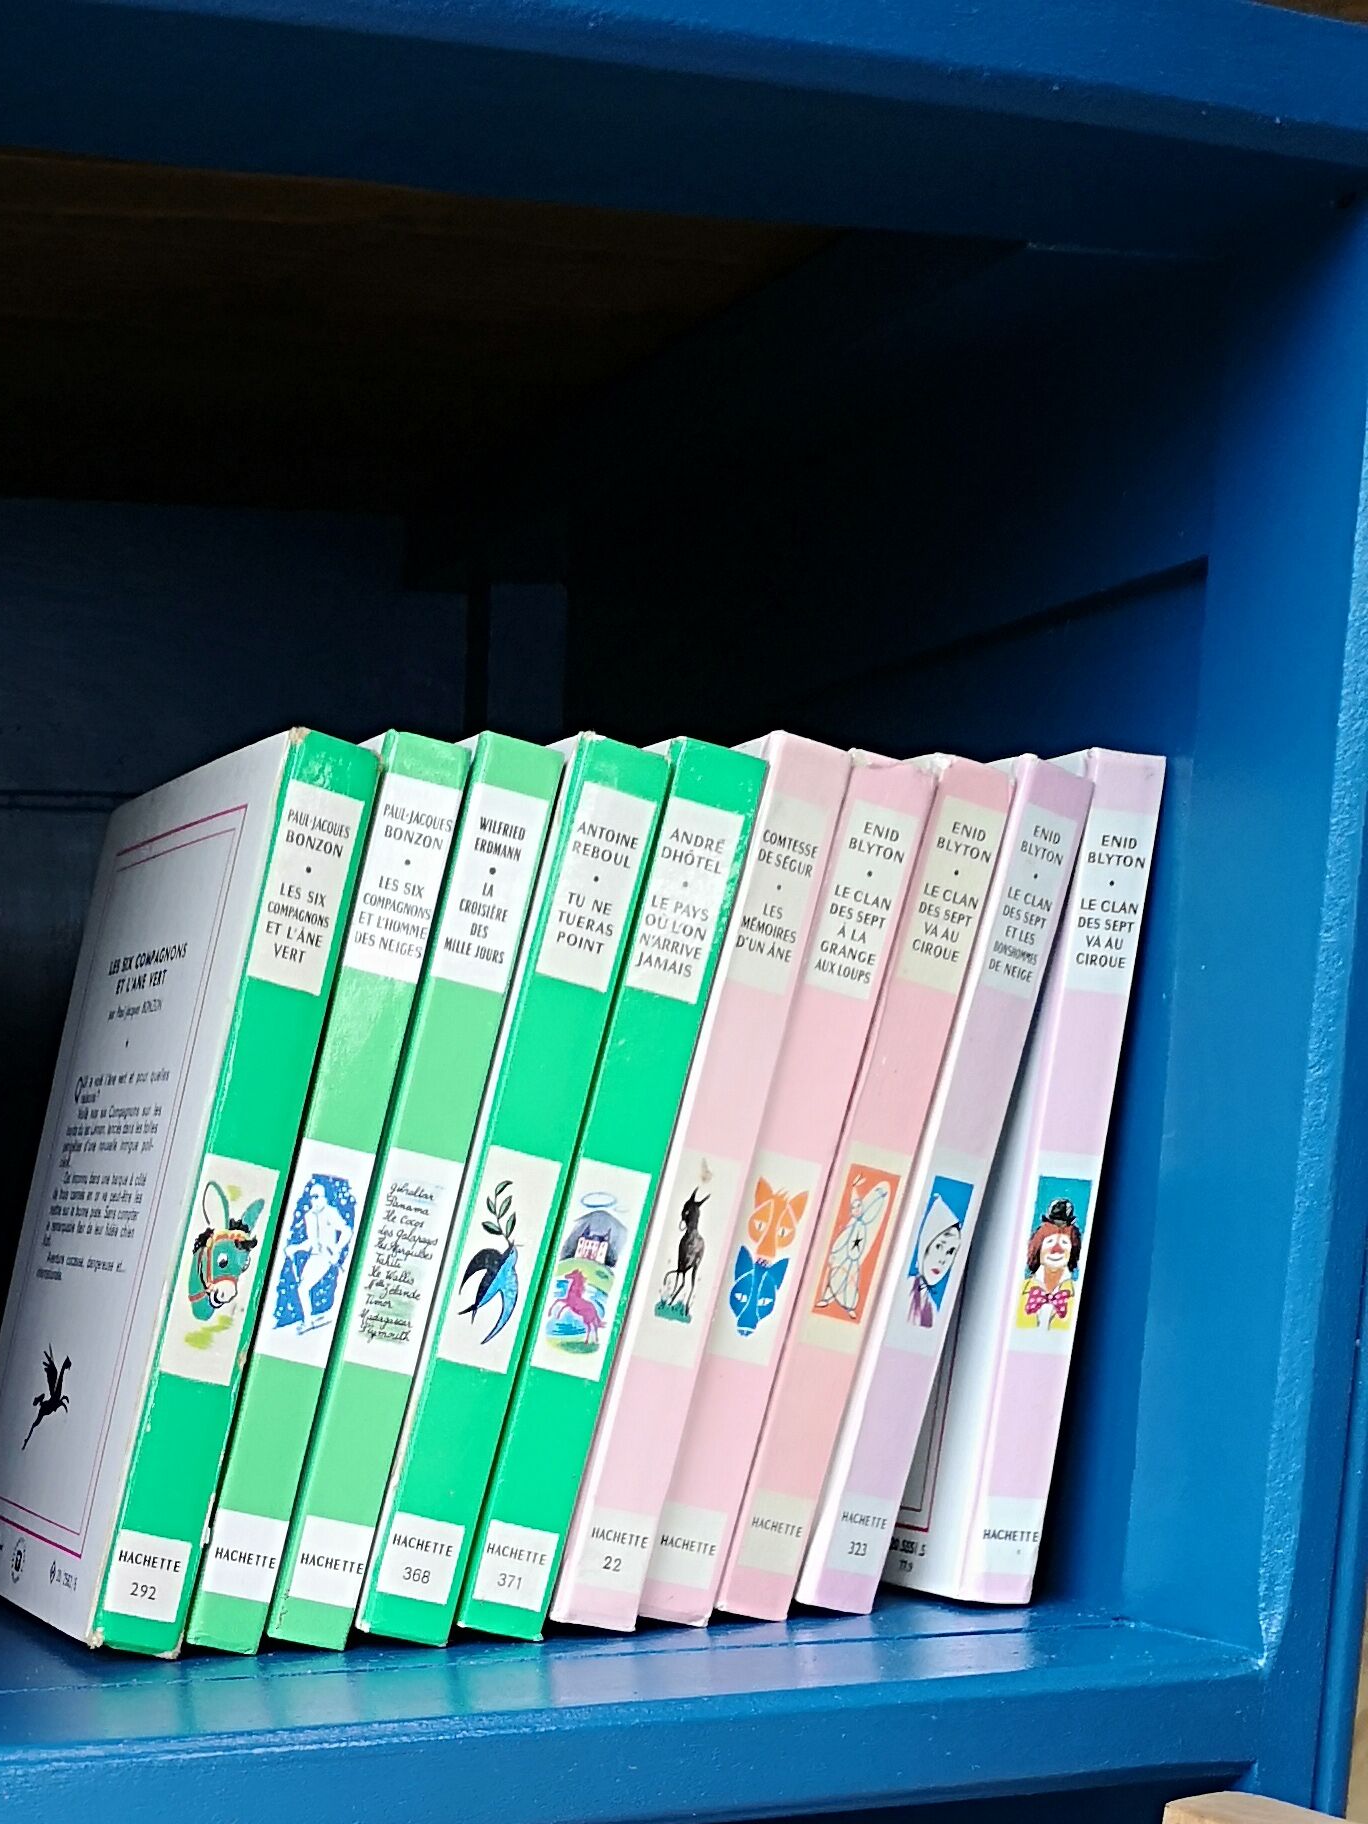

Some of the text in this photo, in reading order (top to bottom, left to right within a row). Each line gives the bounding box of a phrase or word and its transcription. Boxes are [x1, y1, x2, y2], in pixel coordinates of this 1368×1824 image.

[288, 809, 351, 839] PAUL-JACQUES
[383, 803, 453, 832] PAUL-JACQUES
[480, 816, 526, 841] WILFRIED
[286, 829, 343, 858] BONZON
[384, 825, 444, 851] BONZON
[577, 821, 639, 850] ANTOINE
[670, 828, 726, 854] ANDRÉ
[864, 821, 900, 842] ENID
[952, 821, 986, 842] ENID
[1033, 825, 1061, 845] ENID
[1102, 834, 1138, 850] ENID
[474, 837, 521, 862] ERDMANN
[572, 840, 631, 869] REBOUL
[763, 829, 818, 859] COMTESSE
[849, 837, 905, 863] BLYTON
[937, 837, 992, 863] BLYTON
[1021, 841, 1064, 866] BLYTON
[661, 846, 722, 874] DHÔTEL
[758, 848, 814, 877] DE SÉGUR
[1088, 852, 1146, 869] BLYTON
[280, 882, 326, 907] LES SIX
[379, 875, 425, 898] LES SIX
[482, 882, 494, 897] LA
[835, 884, 892, 911] LE CLAN
[924, 883, 979, 910] LE CLAN
[363, 892, 431, 920] COMPAGNONS
[459, 898, 508, 922] CROISIÈRE
[568, 892, 613, 916] TU NE
[652, 895, 709, 922] LE PAYS
[1008, 886, 1052, 912] LE CLAN
[1080, 898, 1138, 914] LE CLAN
[267, 901, 329, 928] COMPAGNONS
[558, 910, 614, 936] TUERAS
[763, 904, 783, 919] LES
[830, 903, 886, 929] DES SEPT
[919, 902, 973, 927] DES SEPT
[1003, 905, 1047, 929] DES SEPT
[266, 921, 283, 935] ET
[358, 911, 428, 940] ET L'HOMME
[470, 923, 489, 938] DES
[672, 920, 707, 941] L'ON
[741, 915, 797, 944] MÉMOIRES
[851, 929, 866, 944] LA
[924, 922, 960, 943] VA AU
[1005, 925, 1035, 945] ET LES
[1078, 916, 1135, 933] DES SEPT
[274, 942, 306, 963] VERT
[355, 930, 422, 959] DES NEIGES
[444, 937, 505, 964] MILLE JOURS
[557, 931, 605, 954] POINT
[640, 933, 702, 960] N'ARRIVE
[736, 935, 765, 955] D'UN
[820, 940, 876, 966] GRANGE
[912, 939, 960, 962] CIRQUE
[1086, 935, 1124, 950] VA AU
[135, 942, 188, 970] COMPAGNONS
[635, 952, 693, 978] JAMAIS
[1076, 952, 1127, 969] CIRQUE
[149, 969, 168, 987] VERT
[815, 958, 871, 984] AUX LOUPS
[989, 958, 1033, 983] DE NEIGE
[752, 1516, 803, 1539] HACHETTE
[840, 1511, 887, 1530] HACHETTE
[392, 1532, 454, 1557] HACHETTE
[591, 1526, 648, 1550] HACHETTE
[660, 1533, 717, 1556] HACHETTE
[982, 1528, 1040, 1543] HACHETTE
[215, 1546, 276, 1570] HACHETTE
[486, 1541, 548, 1567] HACHETTE
[848, 1540, 867, 1557] 323
[118, 1549, 182, 1573] HACHETTE
[300, 1552, 364, 1576] HACHETTE
[603, 1555, 622, 1573] 22
[402, 1566, 431, 1585] 368
[497, 1572, 523, 1591] 371
[130, 1582, 157, 1600] 292
